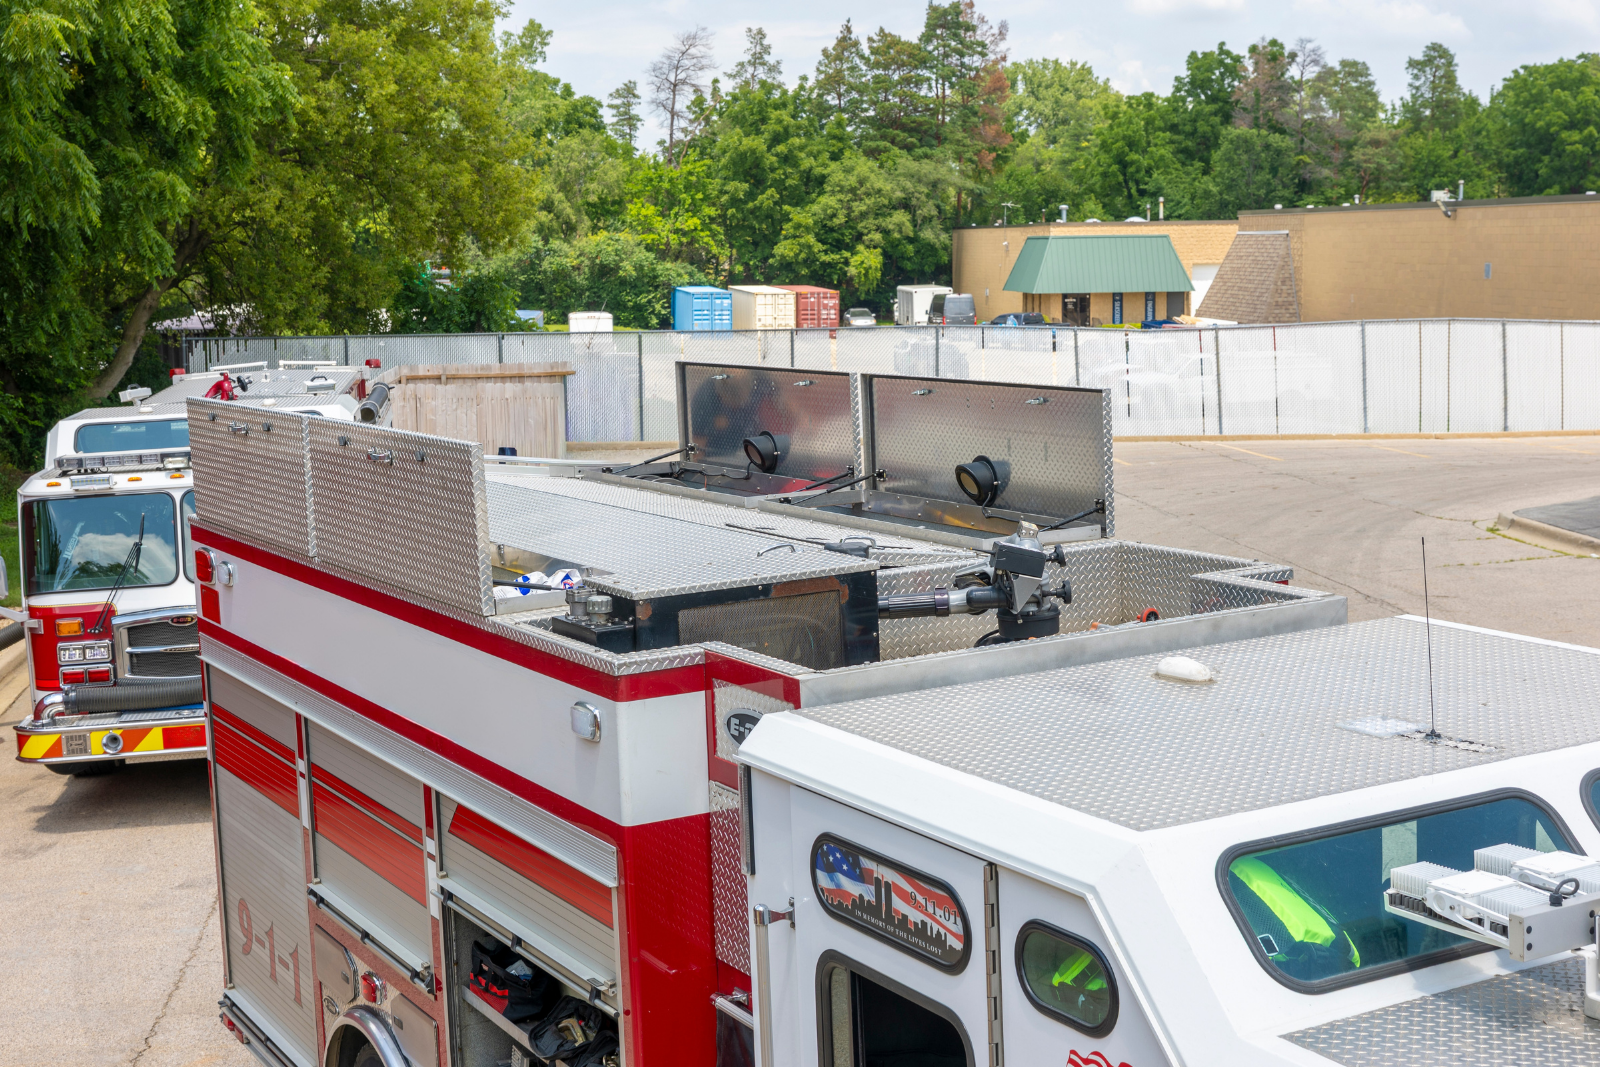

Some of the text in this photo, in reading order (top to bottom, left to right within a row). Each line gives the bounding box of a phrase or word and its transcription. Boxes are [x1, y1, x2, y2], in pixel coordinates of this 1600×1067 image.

[909, 891, 959, 926] 9.11.01
[238, 898, 303, 1009] 9-1-1
[855, 909, 942, 956] IN MEMORY OF THE LIVES LOST
